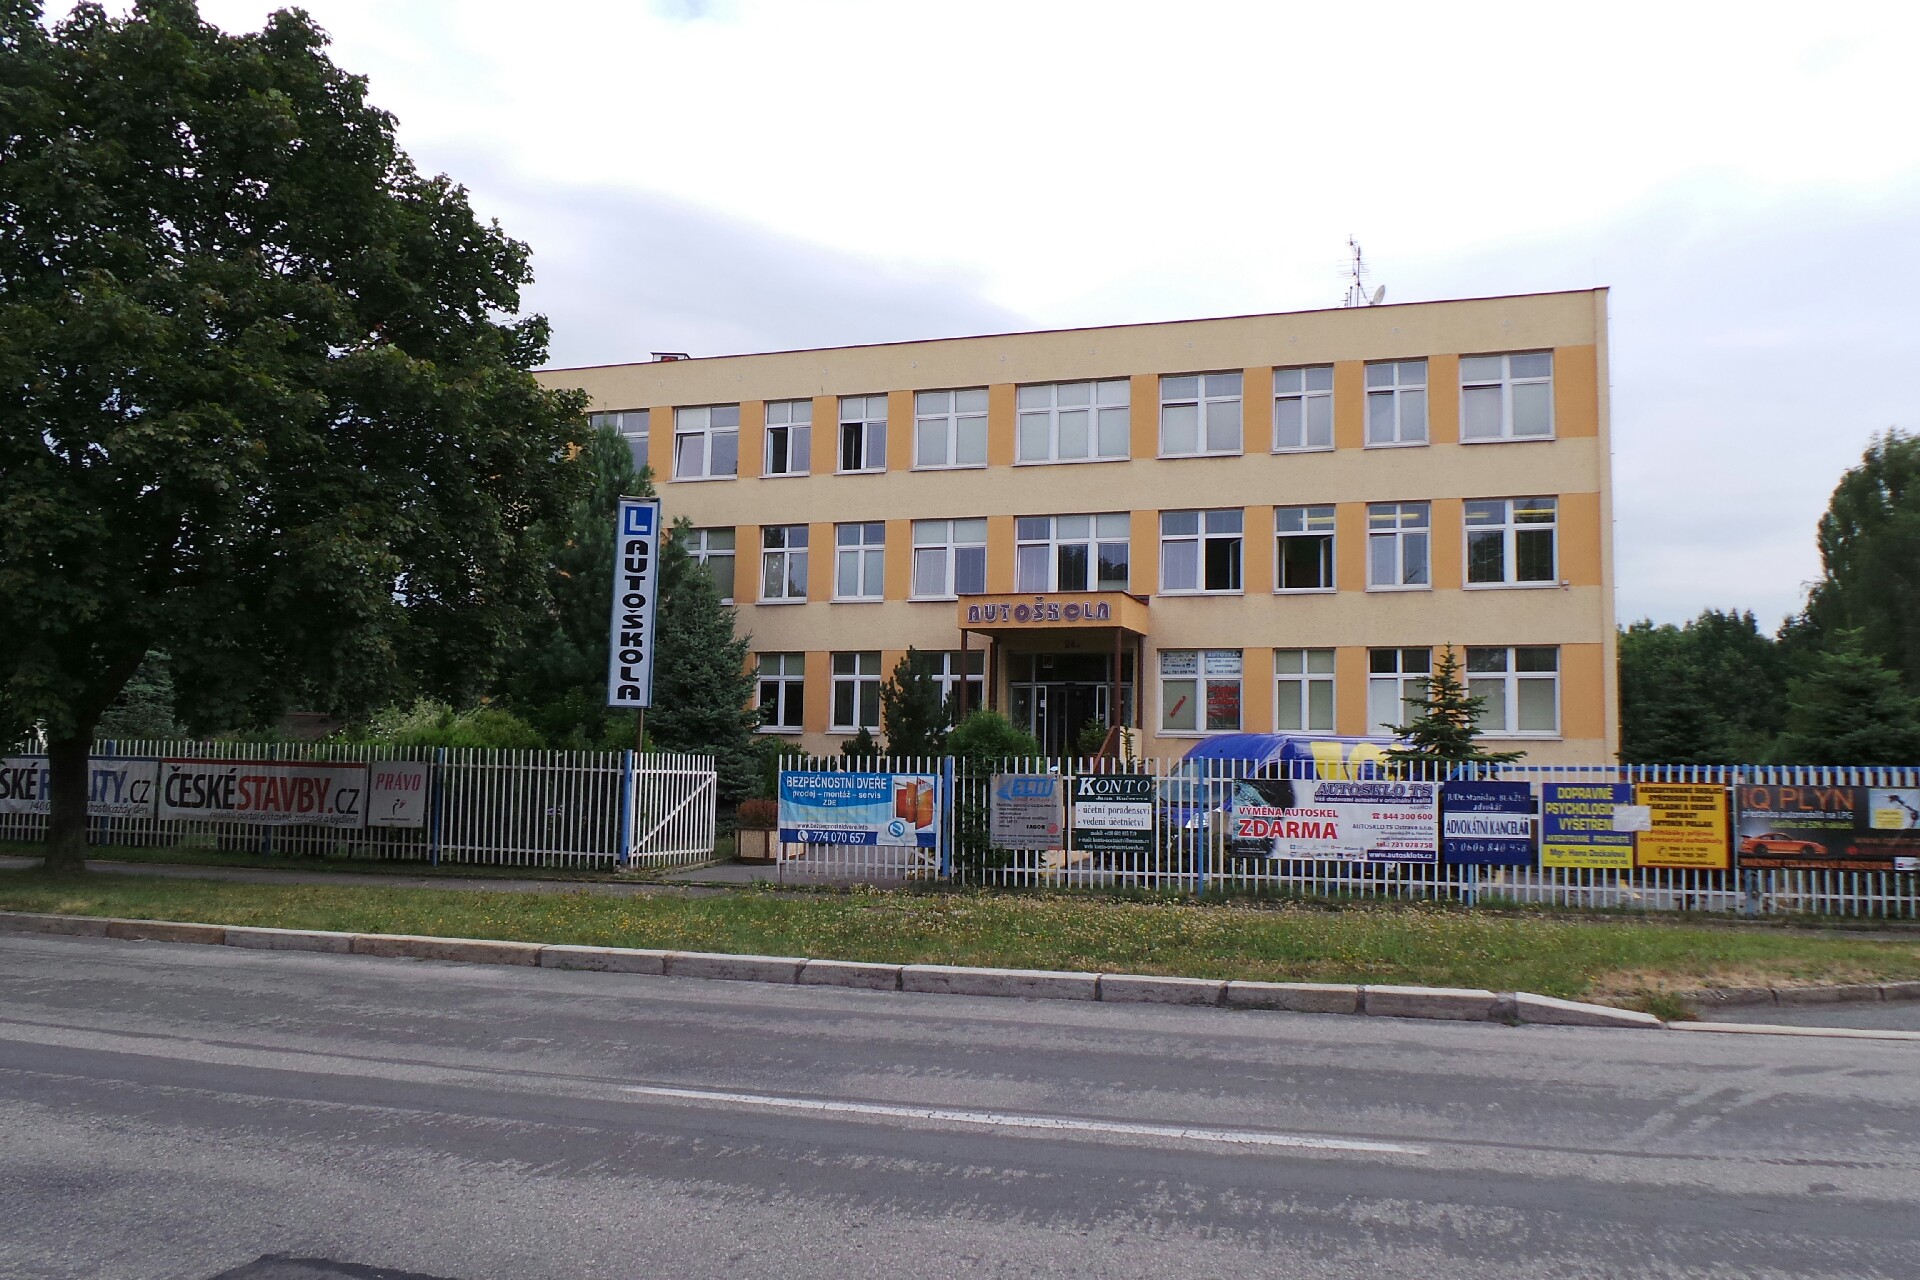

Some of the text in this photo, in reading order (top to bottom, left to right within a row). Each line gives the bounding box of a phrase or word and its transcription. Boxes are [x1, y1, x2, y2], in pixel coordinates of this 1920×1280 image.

[966, 596, 1111, 623] AUTOŠKOLA
[617, 539, 649, 701] AUTOŠKOLA
[375, 771, 421, 791] PRÁVO
[786, 775, 887, 790] BEZPEČNOSTNÍ DVEŘE
[1078, 777, 1150, 796] KONTO
[792, 790, 816, 798] prodej
[823, 790, 851, 798] montáž
[1315, 782, 1433, 797] AUTOSKLO TS
[1557, 785, 1614, 800] DOPRAVNĚ
[1466, 793, 1496, 802] Stanislav
[1741, 787, 1855, 811] IQ PLYN
[1083, 805, 1151, 817] účetní poradenství
[1239, 806, 1339, 818] VÝMĚNA AUTOSKEL
[1473, 803, 1502, 811] advokát
[1083, 817, 1145, 828] vedení účetnictví
[1238, 819, 1339, 840] ZDARMA
[1445, 816, 1530, 836] ADVOKÁTNÍ KANCELÁŘ
[812, 832, 828, 842] 774
[831, 832, 847, 843] 070
[850, 833, 866, 844] 657
[1369, 851, 1433, 859] www.autosklots.cz
